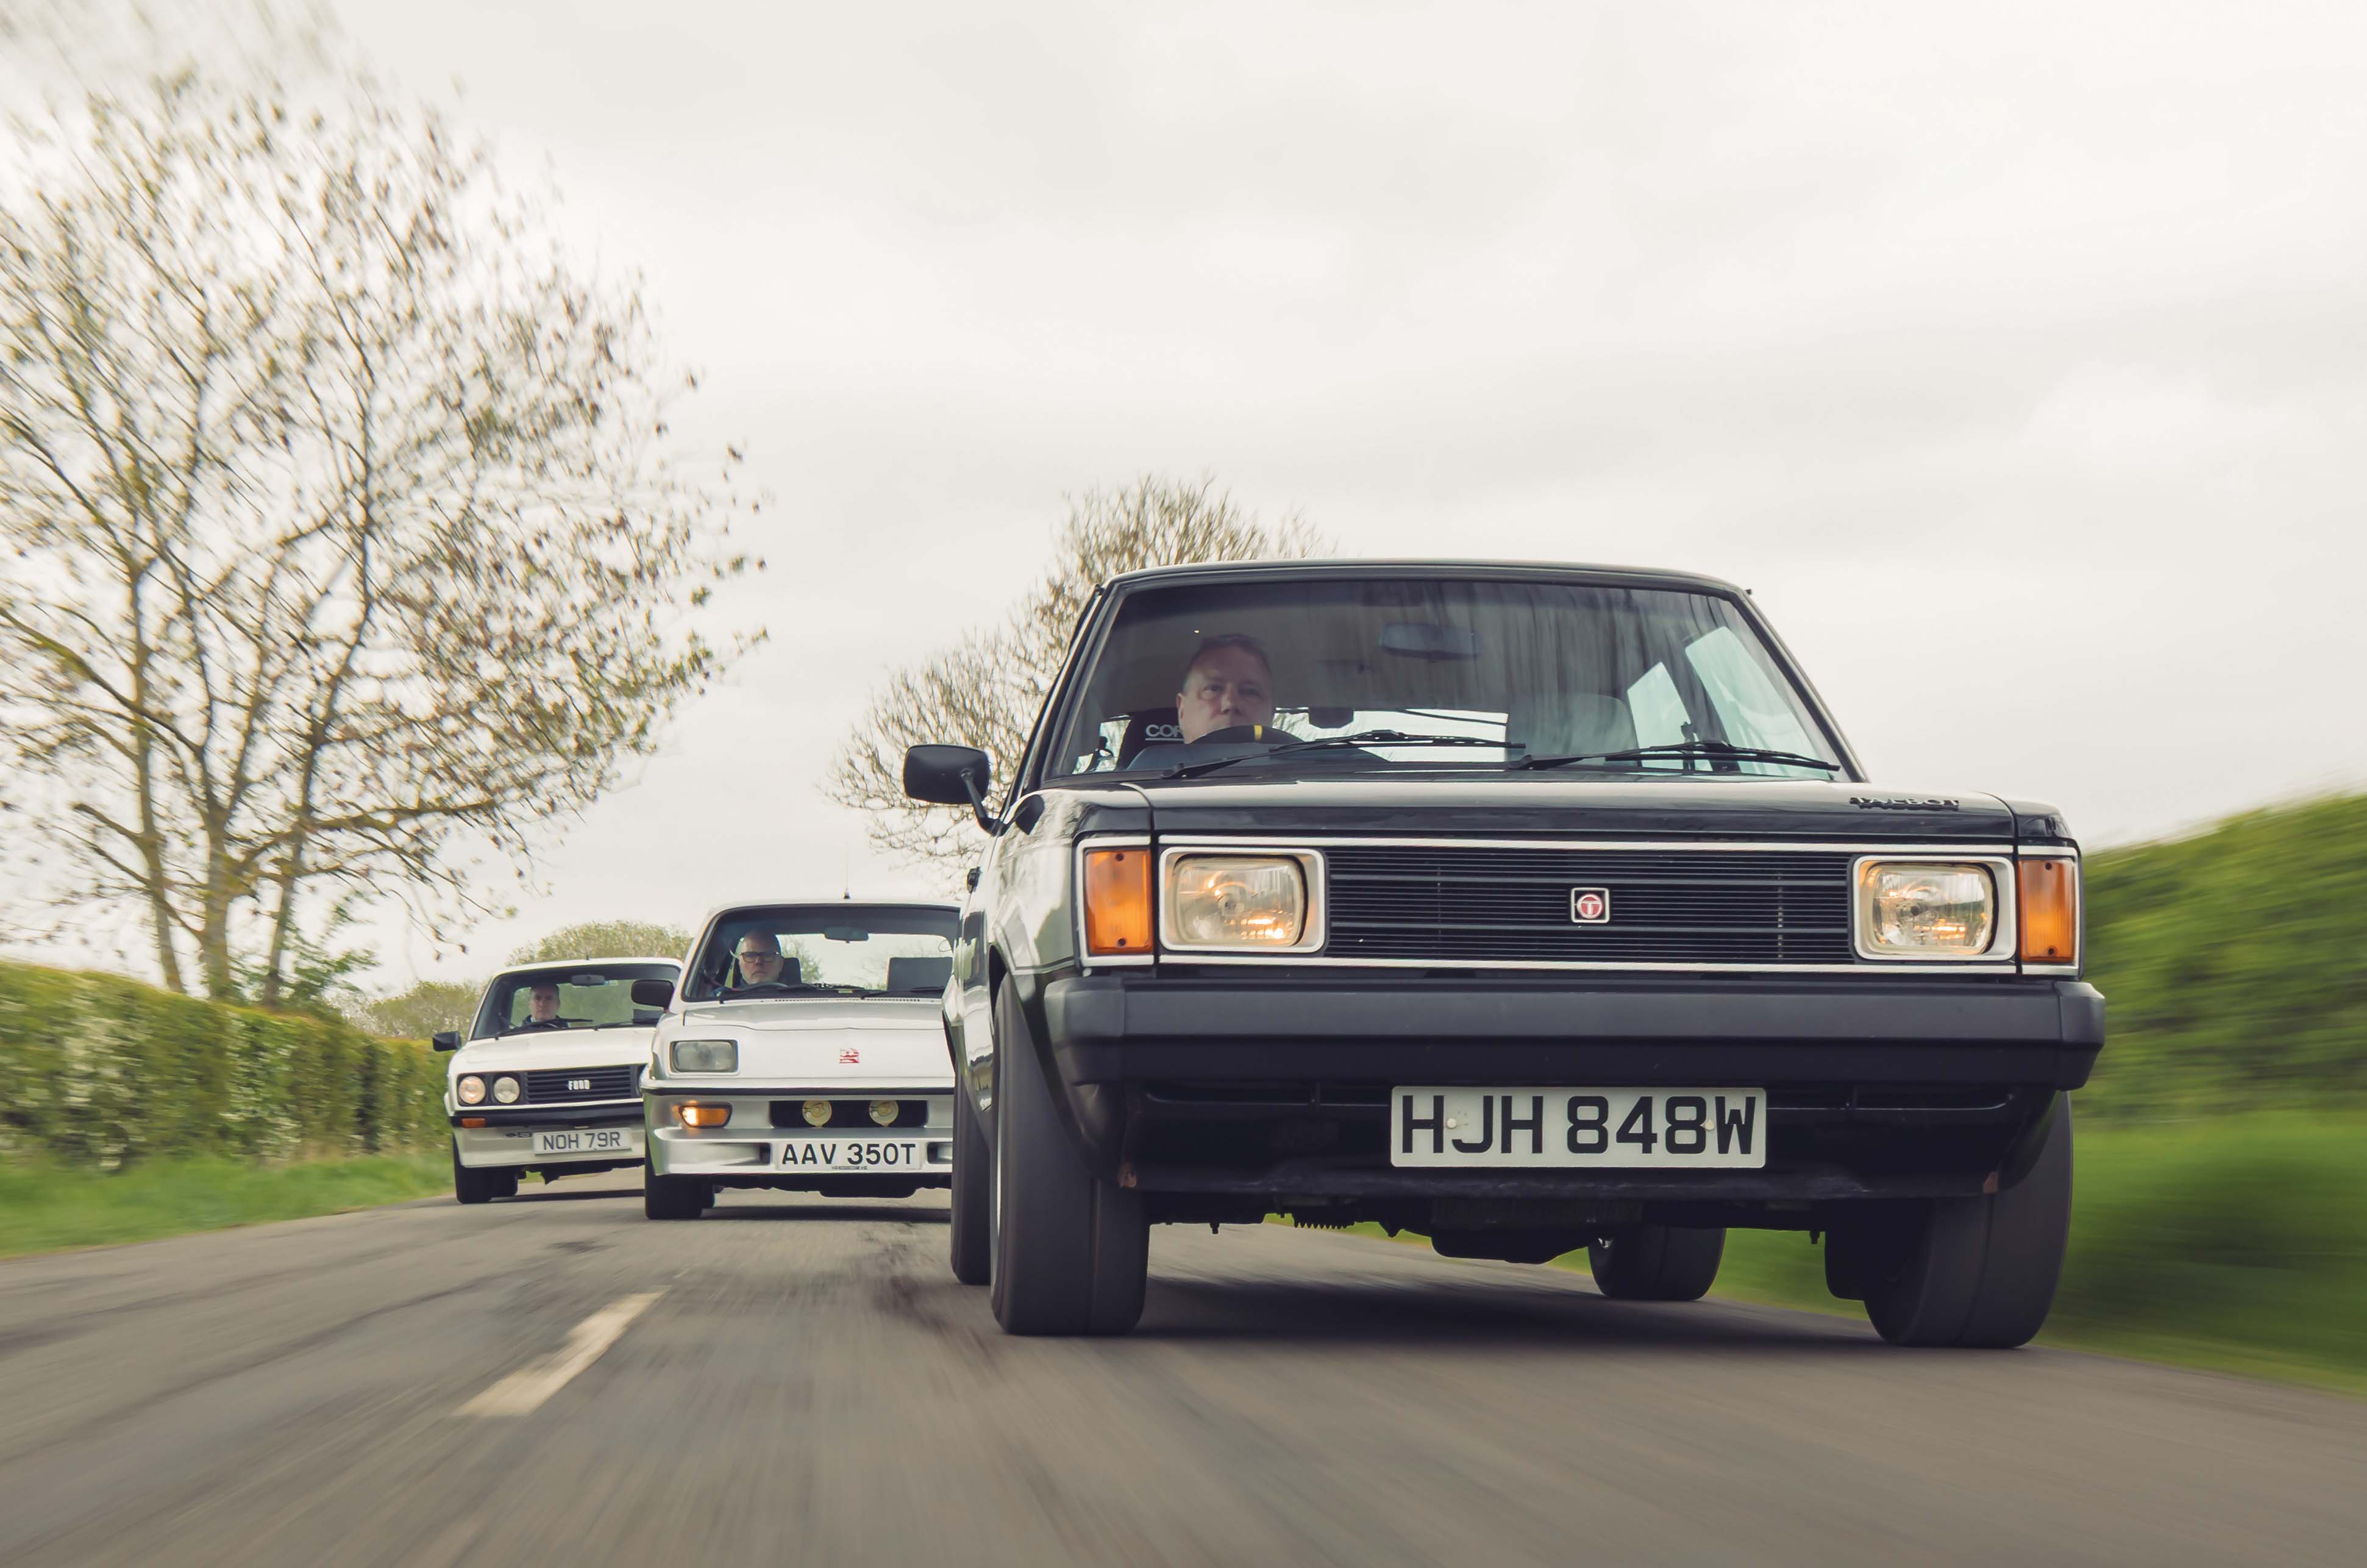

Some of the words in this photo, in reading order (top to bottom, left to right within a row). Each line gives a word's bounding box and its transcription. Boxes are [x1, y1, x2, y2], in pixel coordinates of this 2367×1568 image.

[1401, 1095, 1544, 1154] HJH
[1567, 1096, 1757, 1155] 848W
[543, 1133, 579, 1150] NOH
[585, 1131, 621, 1148] 79R
[782, 1143, 836, 1165] AAV
[847, 1143, 916, 1165] 350T
